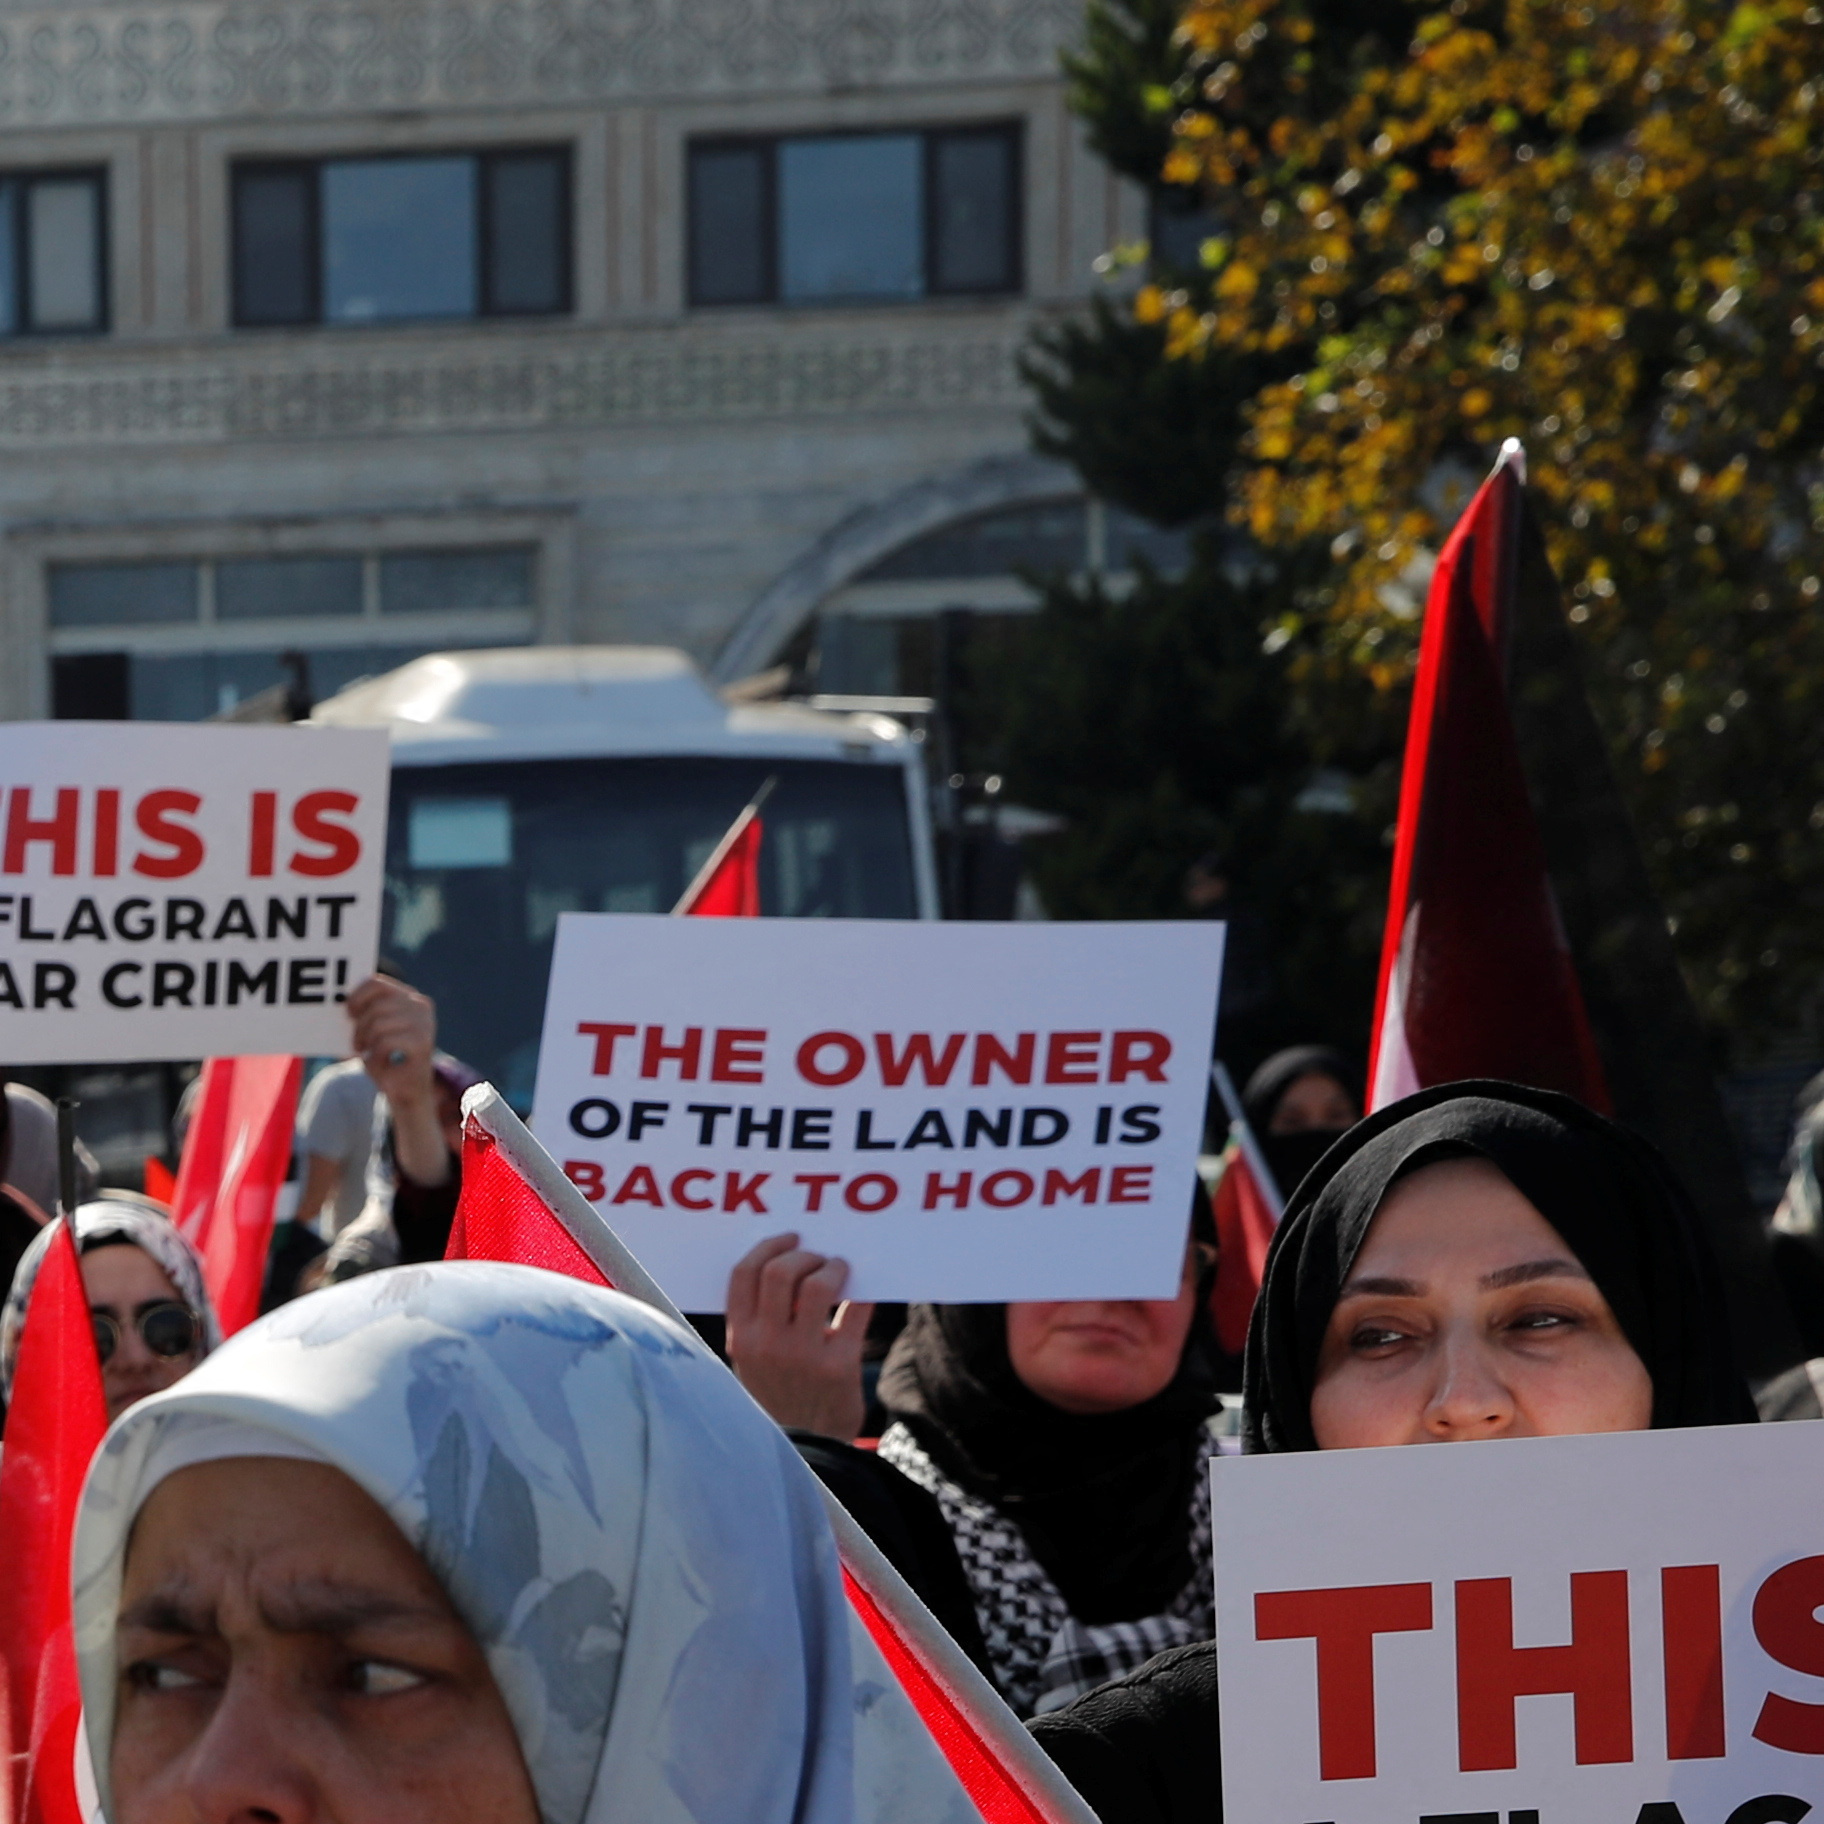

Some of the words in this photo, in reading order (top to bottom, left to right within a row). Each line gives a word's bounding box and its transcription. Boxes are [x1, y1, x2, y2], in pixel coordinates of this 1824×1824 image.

[248, 789, 362, 878] IS
[101, 957, 349, 1009] CRIME!
[577, 1023, 767, 1083] THE
[796, 1030, 1172, 1086] OWNER
[568, 1098, 668, 1140] OF
[687, 1105, 833, 1149] THE
[856, 1108, 1069, 1149] LAND
[1096, 1105, 1161, 1144] IS
[563, 1162, 769, 1213] BACK
[796, 1173, 899, 1213] TO
[921, 1165, 1153, 1211] HOME
